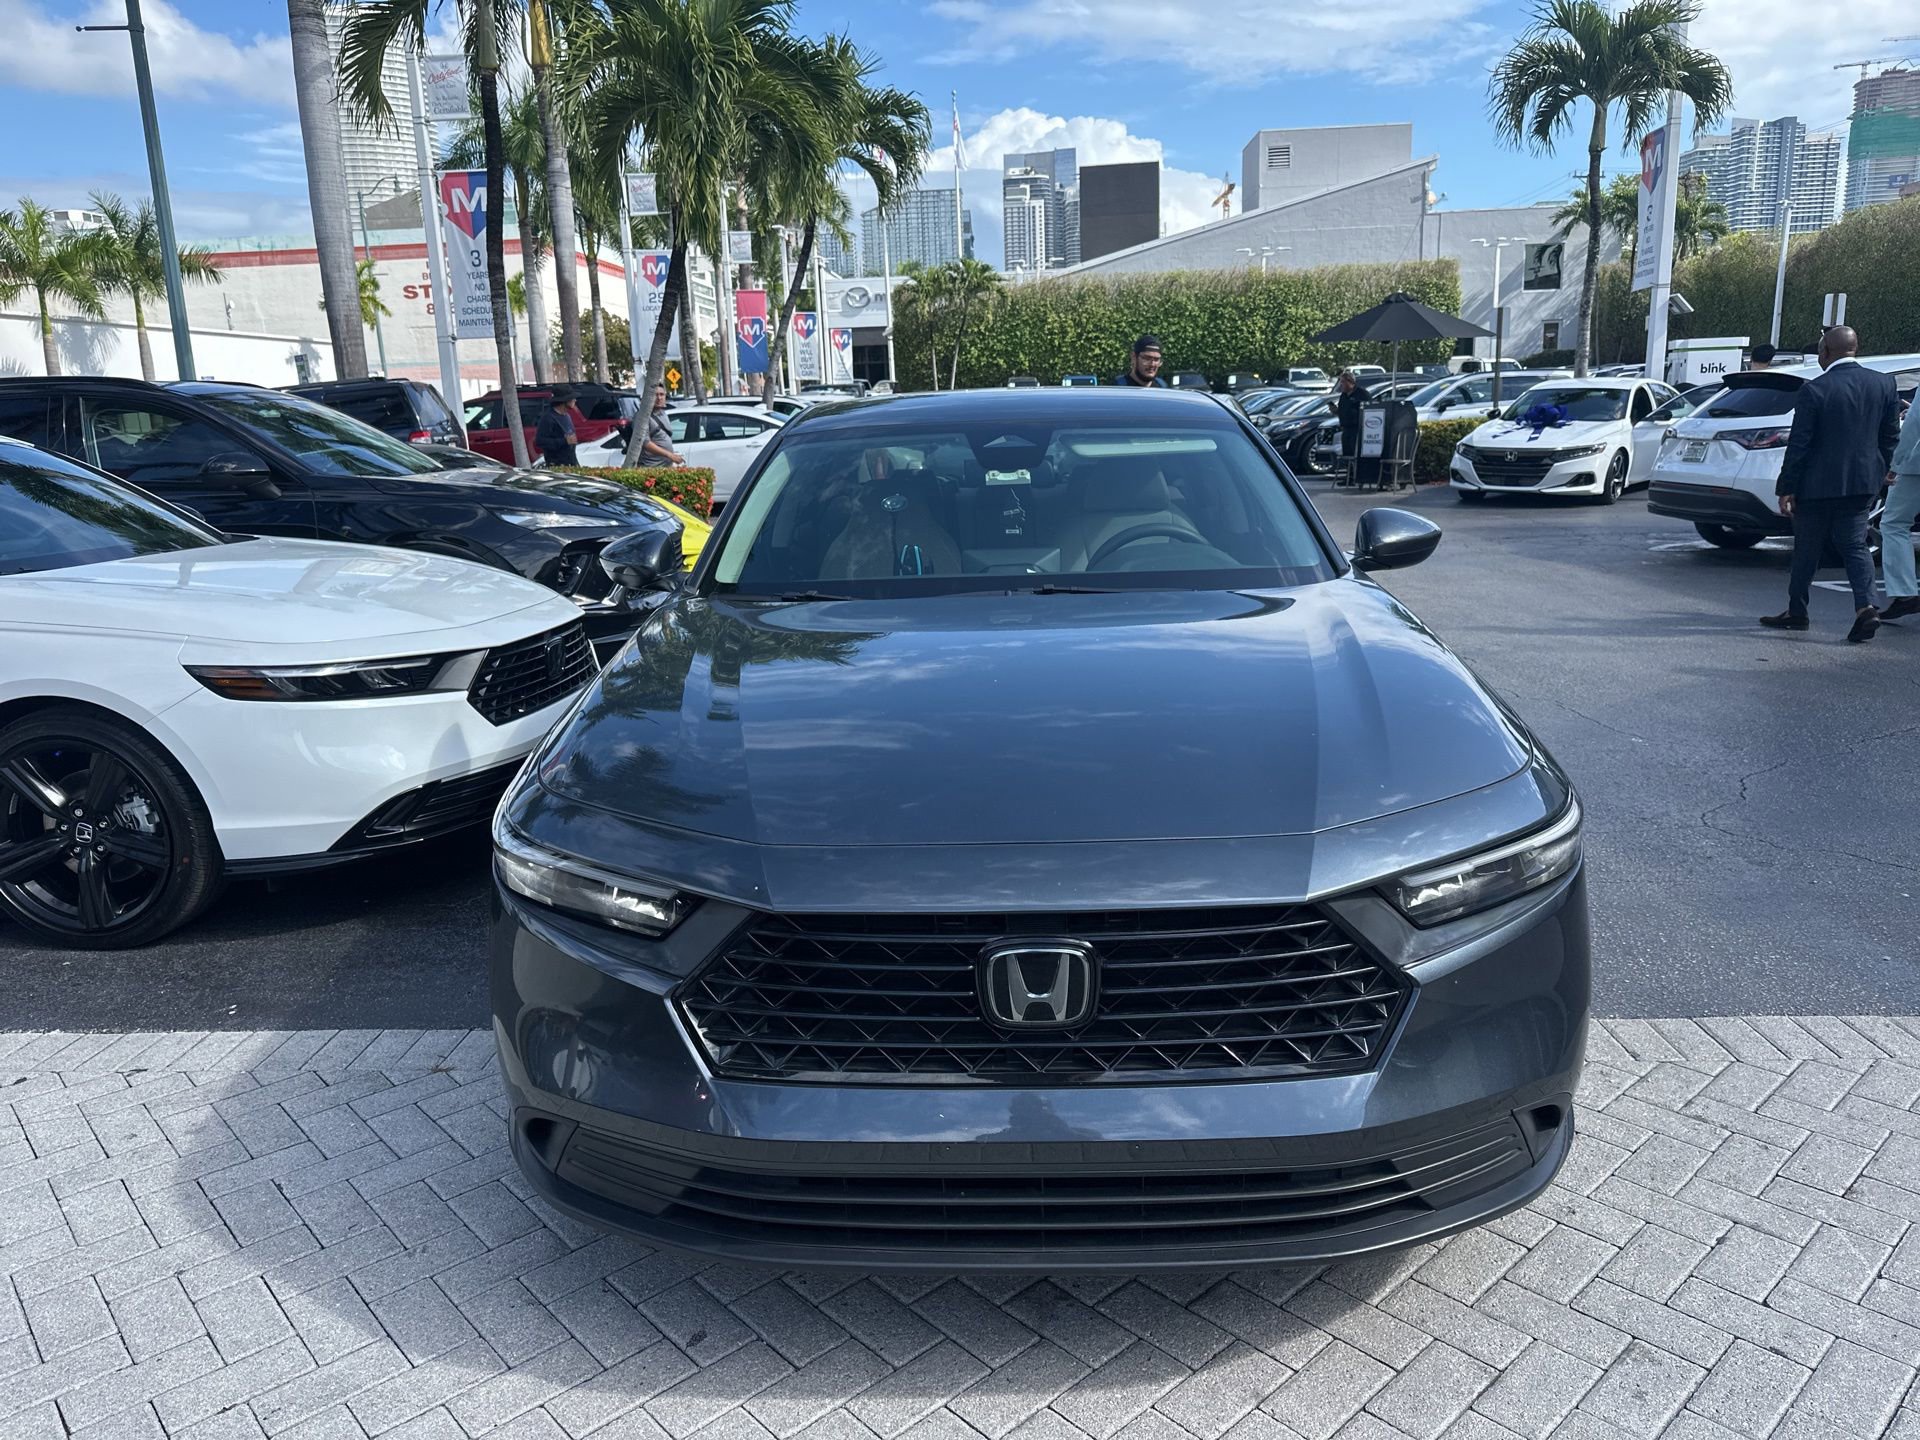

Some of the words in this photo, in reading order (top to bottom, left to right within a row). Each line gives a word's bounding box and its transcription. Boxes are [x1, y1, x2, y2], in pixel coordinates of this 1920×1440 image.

[451, 187, 487, 213] M
[470, 250, 482, 267] 3
[647, 262, 666, 276] M
[467, 295, 492, 303] CHARG
[744, 324, 760, 335] M
[797, 319, 813, 330] M
[1700, 362, 1727, 373] blink
